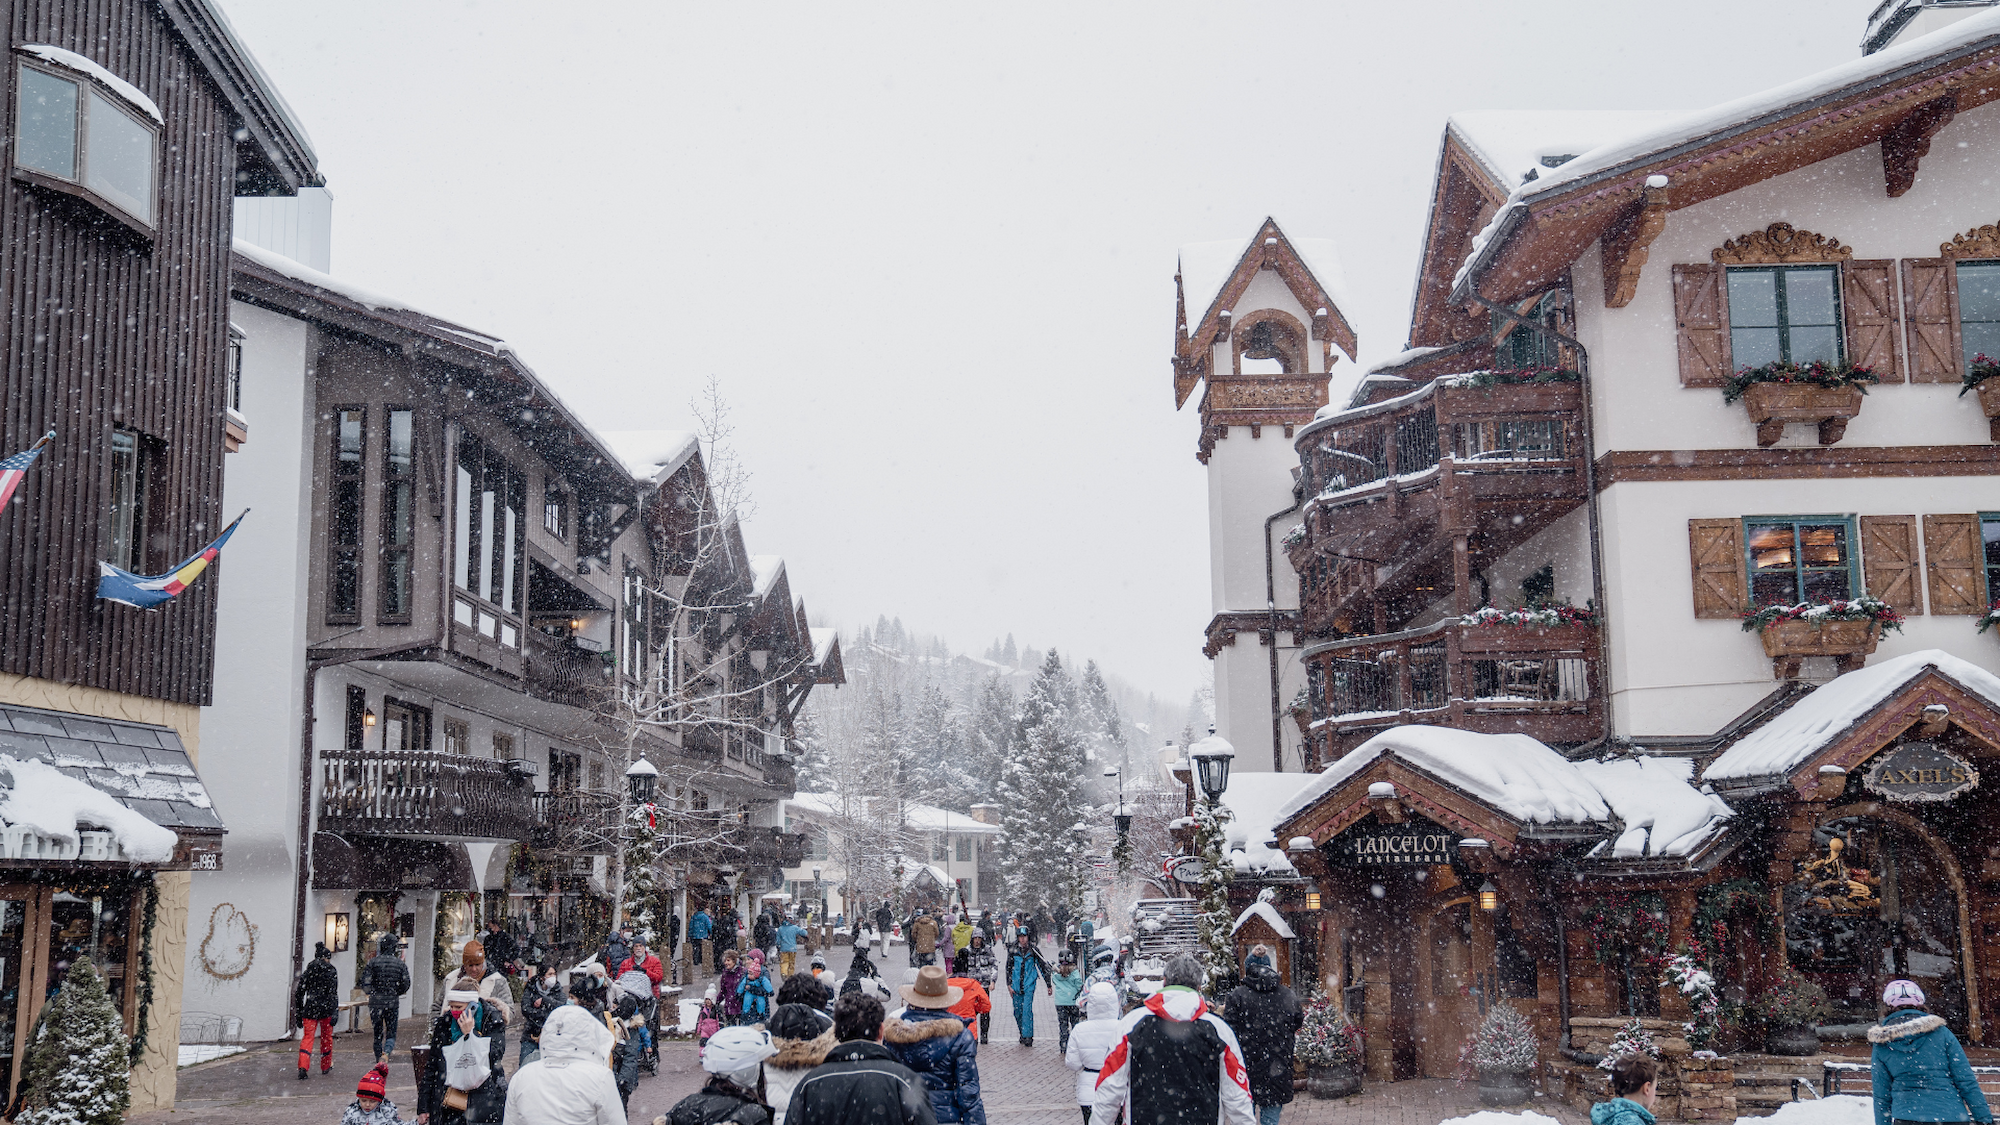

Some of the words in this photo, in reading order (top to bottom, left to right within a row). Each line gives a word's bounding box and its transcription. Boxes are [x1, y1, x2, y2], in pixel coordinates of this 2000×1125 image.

[1880, 767, 1966, 784] AXEL'S
[1356, 834, 1450, 854] LANCELOT
[200, 853, 217, 870] 1968
[1357, 852, 1450, 864] restaurant
